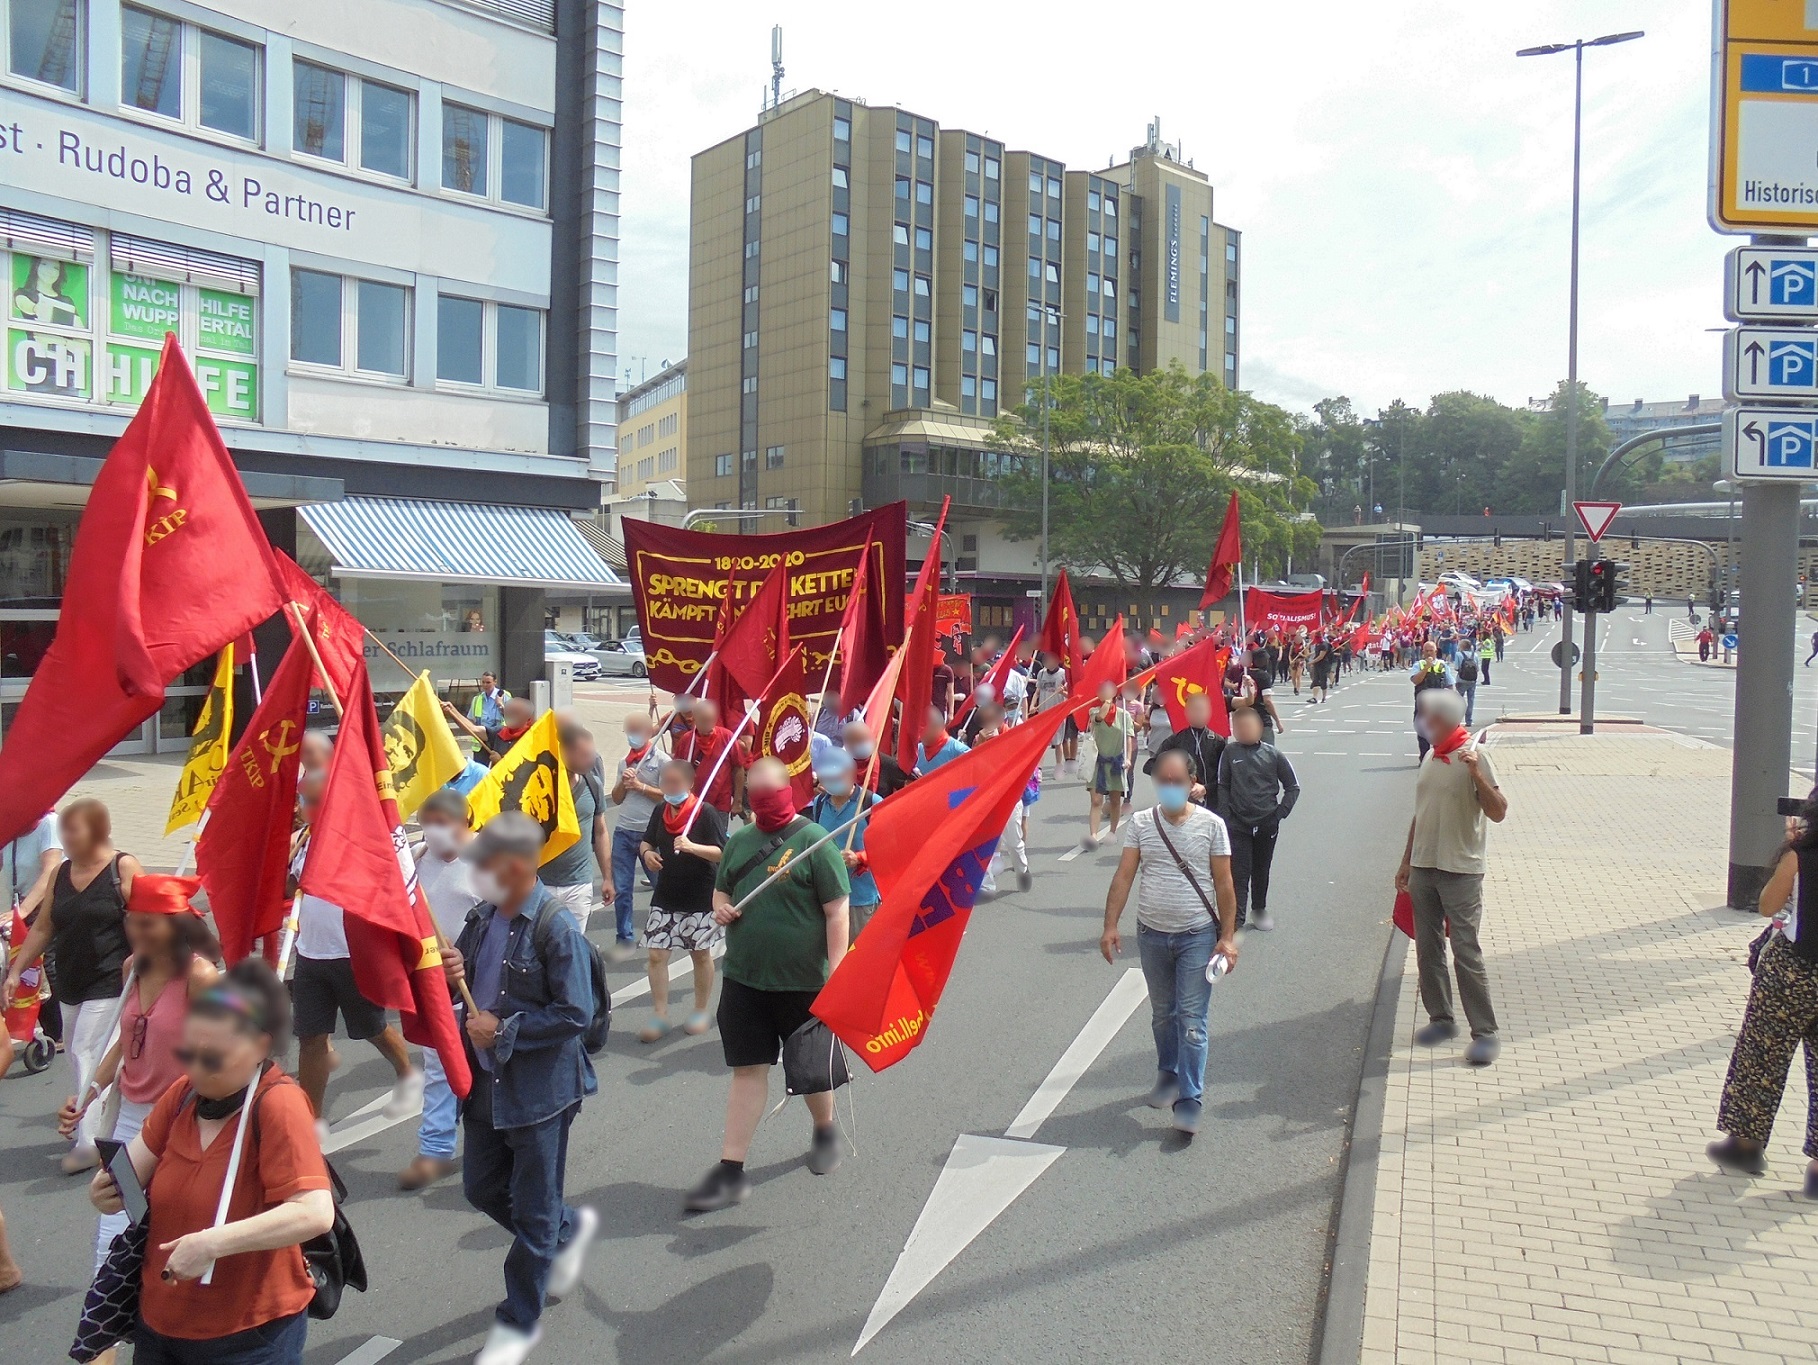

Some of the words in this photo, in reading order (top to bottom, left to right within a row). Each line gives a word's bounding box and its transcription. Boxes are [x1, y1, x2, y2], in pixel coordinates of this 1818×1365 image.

[58, 130, 192, 197] Rudoba
[205, 168, 231, 205] &
[243, 177, 356, 231] Partner
[122, 283, 178, 308] NACH
[200, 298, 250, 321] HILFE
[1784, 275, 1804, 303] P
[122, 303, 179, 326] WUPP
[200, 316, 252, 339] ERTAL
[1783, 356, 1803, 384] P
[1780, 437, 1801, 465] P
[648, 573, 747, 599] SPRENGT
[790, 567, 858, 597] KETTE
[649, 597, 717, 621] KÄMPFT
[387, 640, 490, 658] Schlafraum
